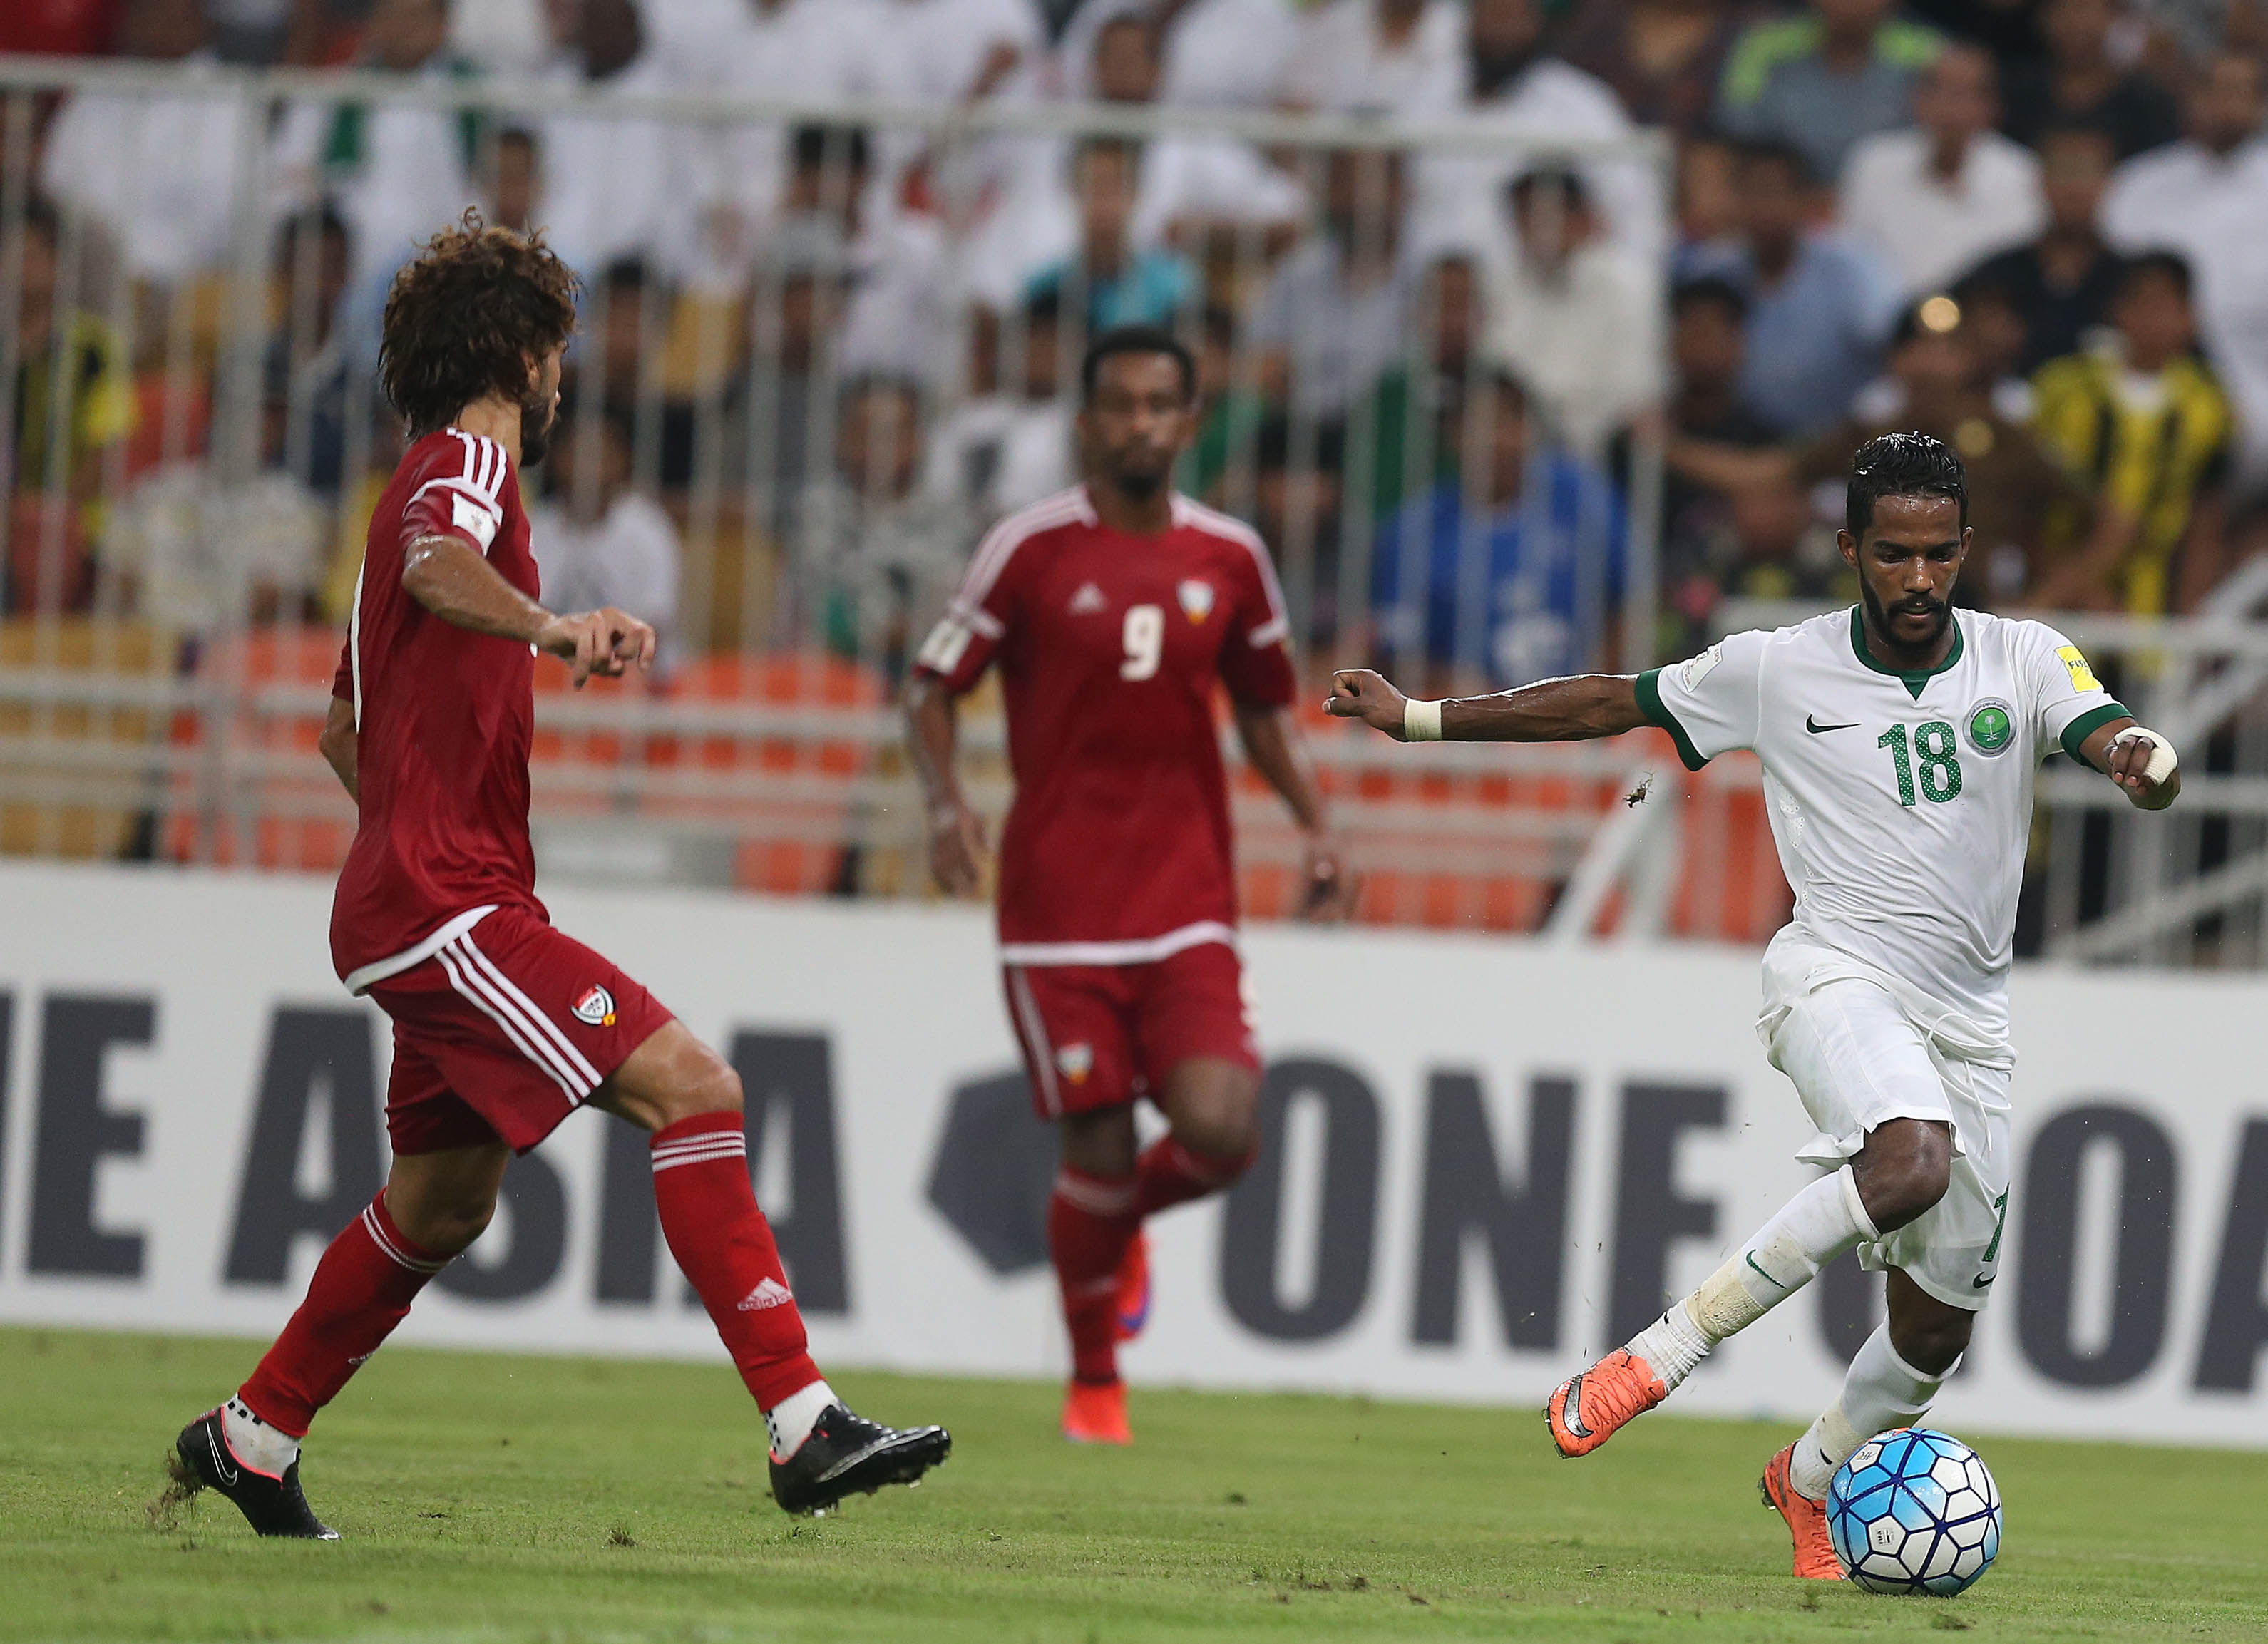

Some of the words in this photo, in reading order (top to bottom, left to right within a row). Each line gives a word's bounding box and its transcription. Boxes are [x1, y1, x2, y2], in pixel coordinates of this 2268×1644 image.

[1120, 604, 1164, 682] 9
[1877, 721, 1962, 806] 18
[0, 993, 155, 1278] E
[1219, 1057, 1730, 1369] ONE
